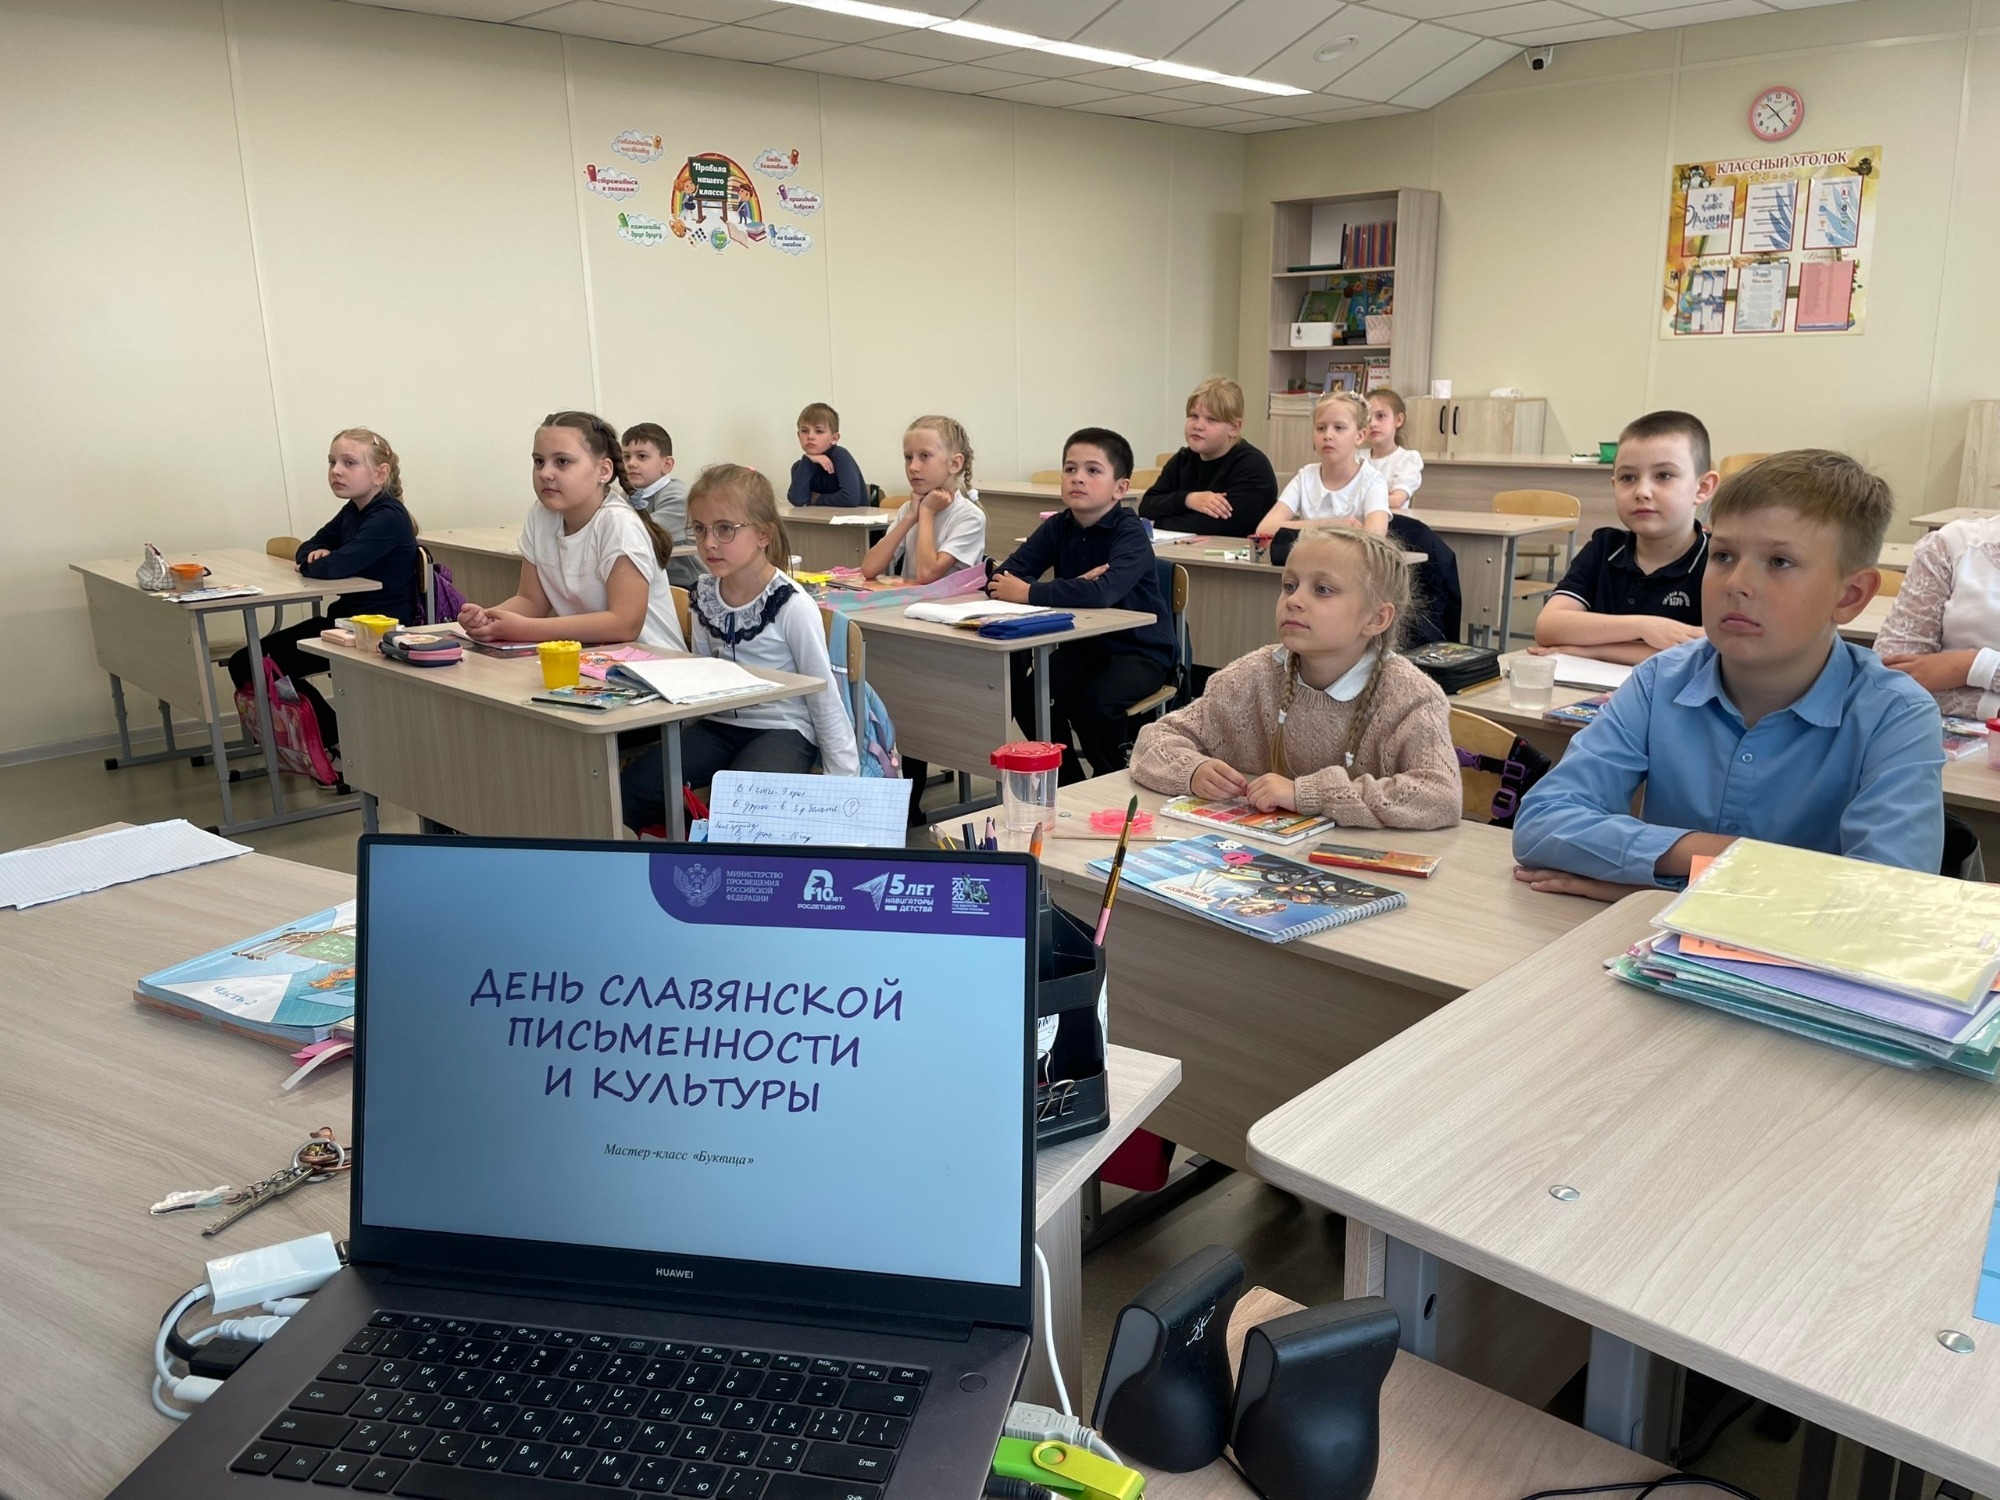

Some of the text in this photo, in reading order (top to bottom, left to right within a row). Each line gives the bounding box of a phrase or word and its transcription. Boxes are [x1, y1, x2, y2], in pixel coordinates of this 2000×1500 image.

[1717, 151, 1847, 174] КЛАССНЫЙ УГОЛОК
[692, 161, 727, 173] Правила
[597, 178, 638, 186] стремиться
[630, 230, 663, 239] друг другу
[726, 870, 784, 879] МИНИСТЕРСТВО
[726, 878, 780, 887] ПРОСВЕЩЕНИЯ
[888, 873, 935, 896] 5 ЛЕТ
[951, 880, 965, 891] 20
[726, 886, 774, 895] РОССИЙСКОЙ
[815, 886, 834, 902] 10
[1183, 890, 1201, 899] YOUR
[726, 894, 769, 902] ФЕДЕРАЦИИ
[951, 890, 965, 901] 26
[885, 897, 934, 906] НАВИГАТОРЫ
[797, 903, 846, 911] РОСДЕТЦЕНТР
[899, 905, 933, 913] ДЕТСТВА
[213, 986, 245, 1003] Часть
[470, 968, 902, 1021] ДЕНЬ СЛАВЯНСКОЙ
[508, 1016, 860, 1068] ПИСЬМЕННОСТИ
[544, 1065, 820, 1113] И КУЛЬТУРЫ
[604, 1143, 754, 1167] Мастер-класс «Буквица»
[655, 1267, 694, 1279] HUAWEI
[382, 1363, 394, 1372] Q
[420, 1367, 434, 1375] W
[495, 1376, 505, 1384] R
[646, 1372, 655, 1380] 8
[536, 1380, 545, 1388] T
[366, 1393, 377, 1401] A
[613, 1389, 624, 1397] U
[443, 1402, 455, 1410] D
[523, 1412, 534, 1420] G
[561, 1416, 574, 1424] H
[700, 1412, 713, 1421] Щ
[359, 1425, 371, 1433] Z
[603, 1421, 611, 1429] J
[643, 1426, 655, 1434] K
[685, 1431, 692, 1439] L
[480, 1441, 491, 1449] V
[519, 1446, 529, 1454] B
[695, 1446, 706, 1454] Д
[560, 1451, 572, 1459] N
[601, 1456, 616, 1465] M
[857, 1459, 877, 1467] Enter
[696, 1483, 709, 1491] Ю
